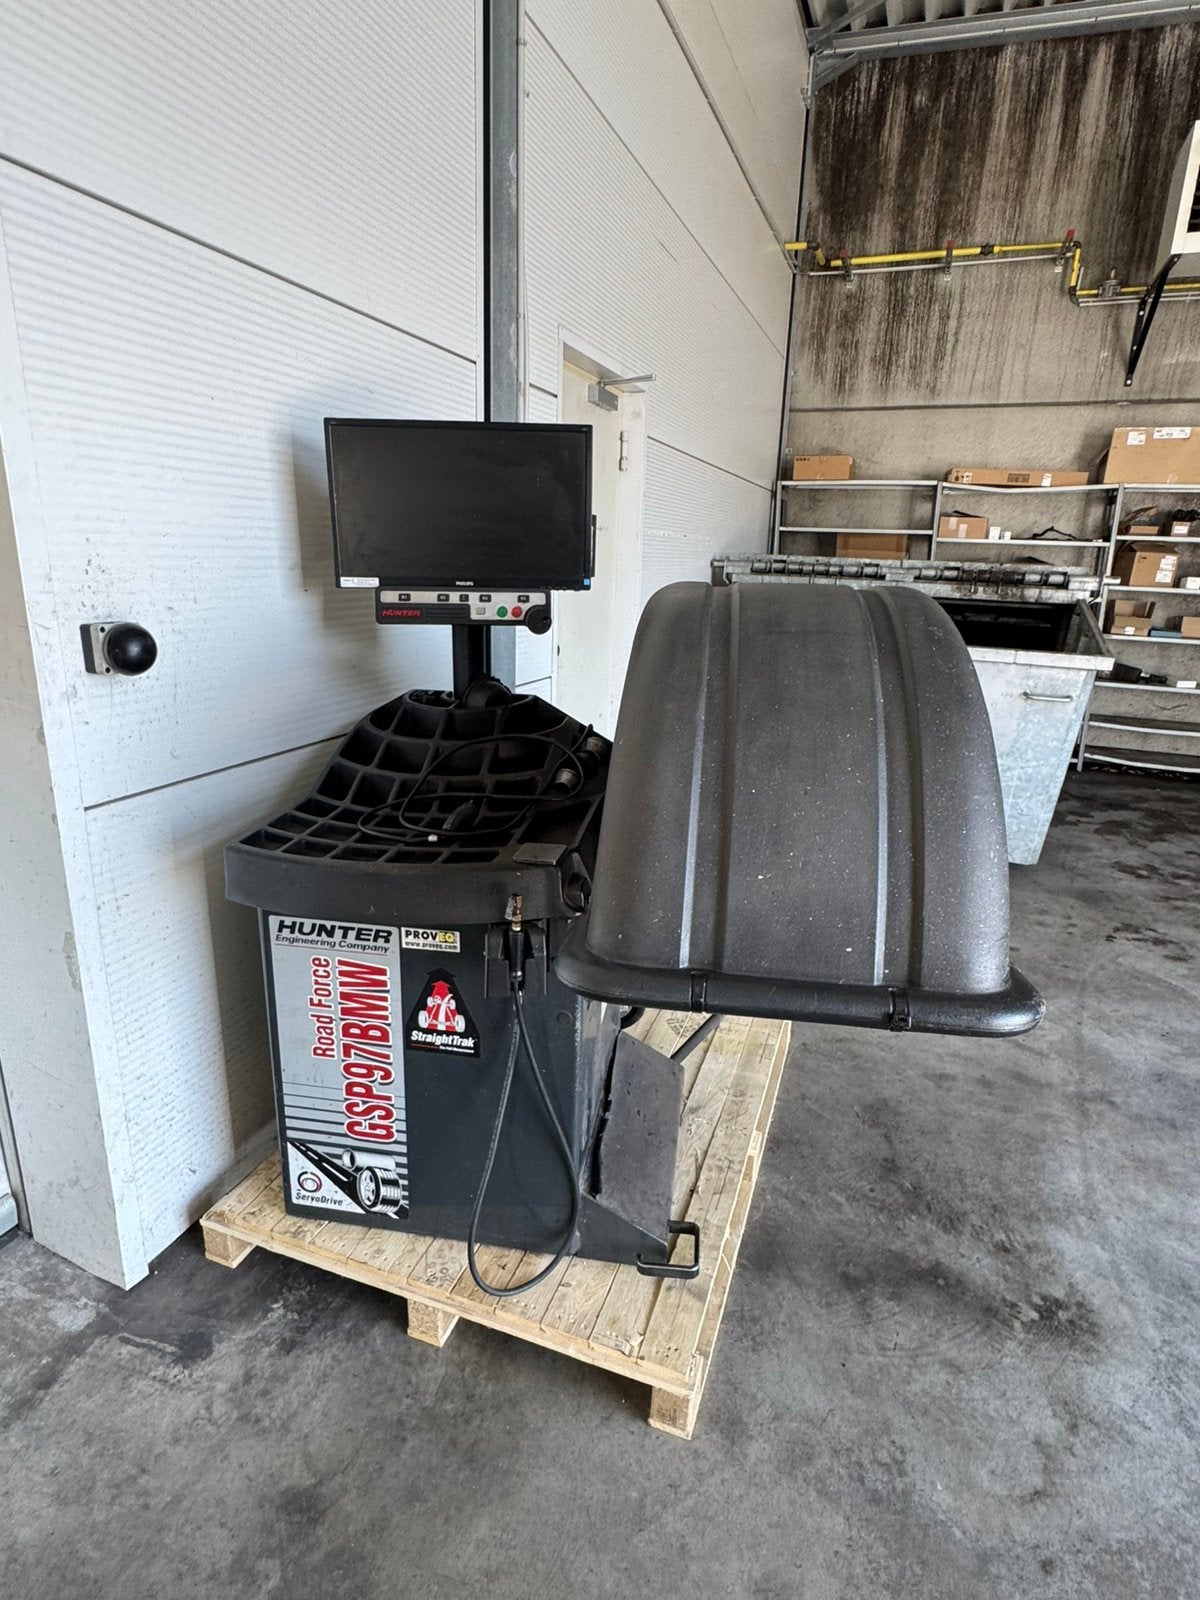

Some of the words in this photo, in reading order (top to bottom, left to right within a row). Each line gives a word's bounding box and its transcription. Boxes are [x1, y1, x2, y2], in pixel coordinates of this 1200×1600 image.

[382, 609, 421, 617] HUNTER
[277, 919, 393, 944] HUNTER
[405, 929, 455, 944] PROVEQ
[275, 933, 336, 949] Engineering
[338, 939, 390, 954] Company
[405, 941, 458, 951] www.proveq.com
[309, 957, 333, 1010] Force
[310, 1012, 336, 1058] Road
[411, 1030, 475, 1048] StraightTrak
[337, 959, 396, 1142] GSP97BMW
[295, 1191, 343, 1207] ServoDrive
